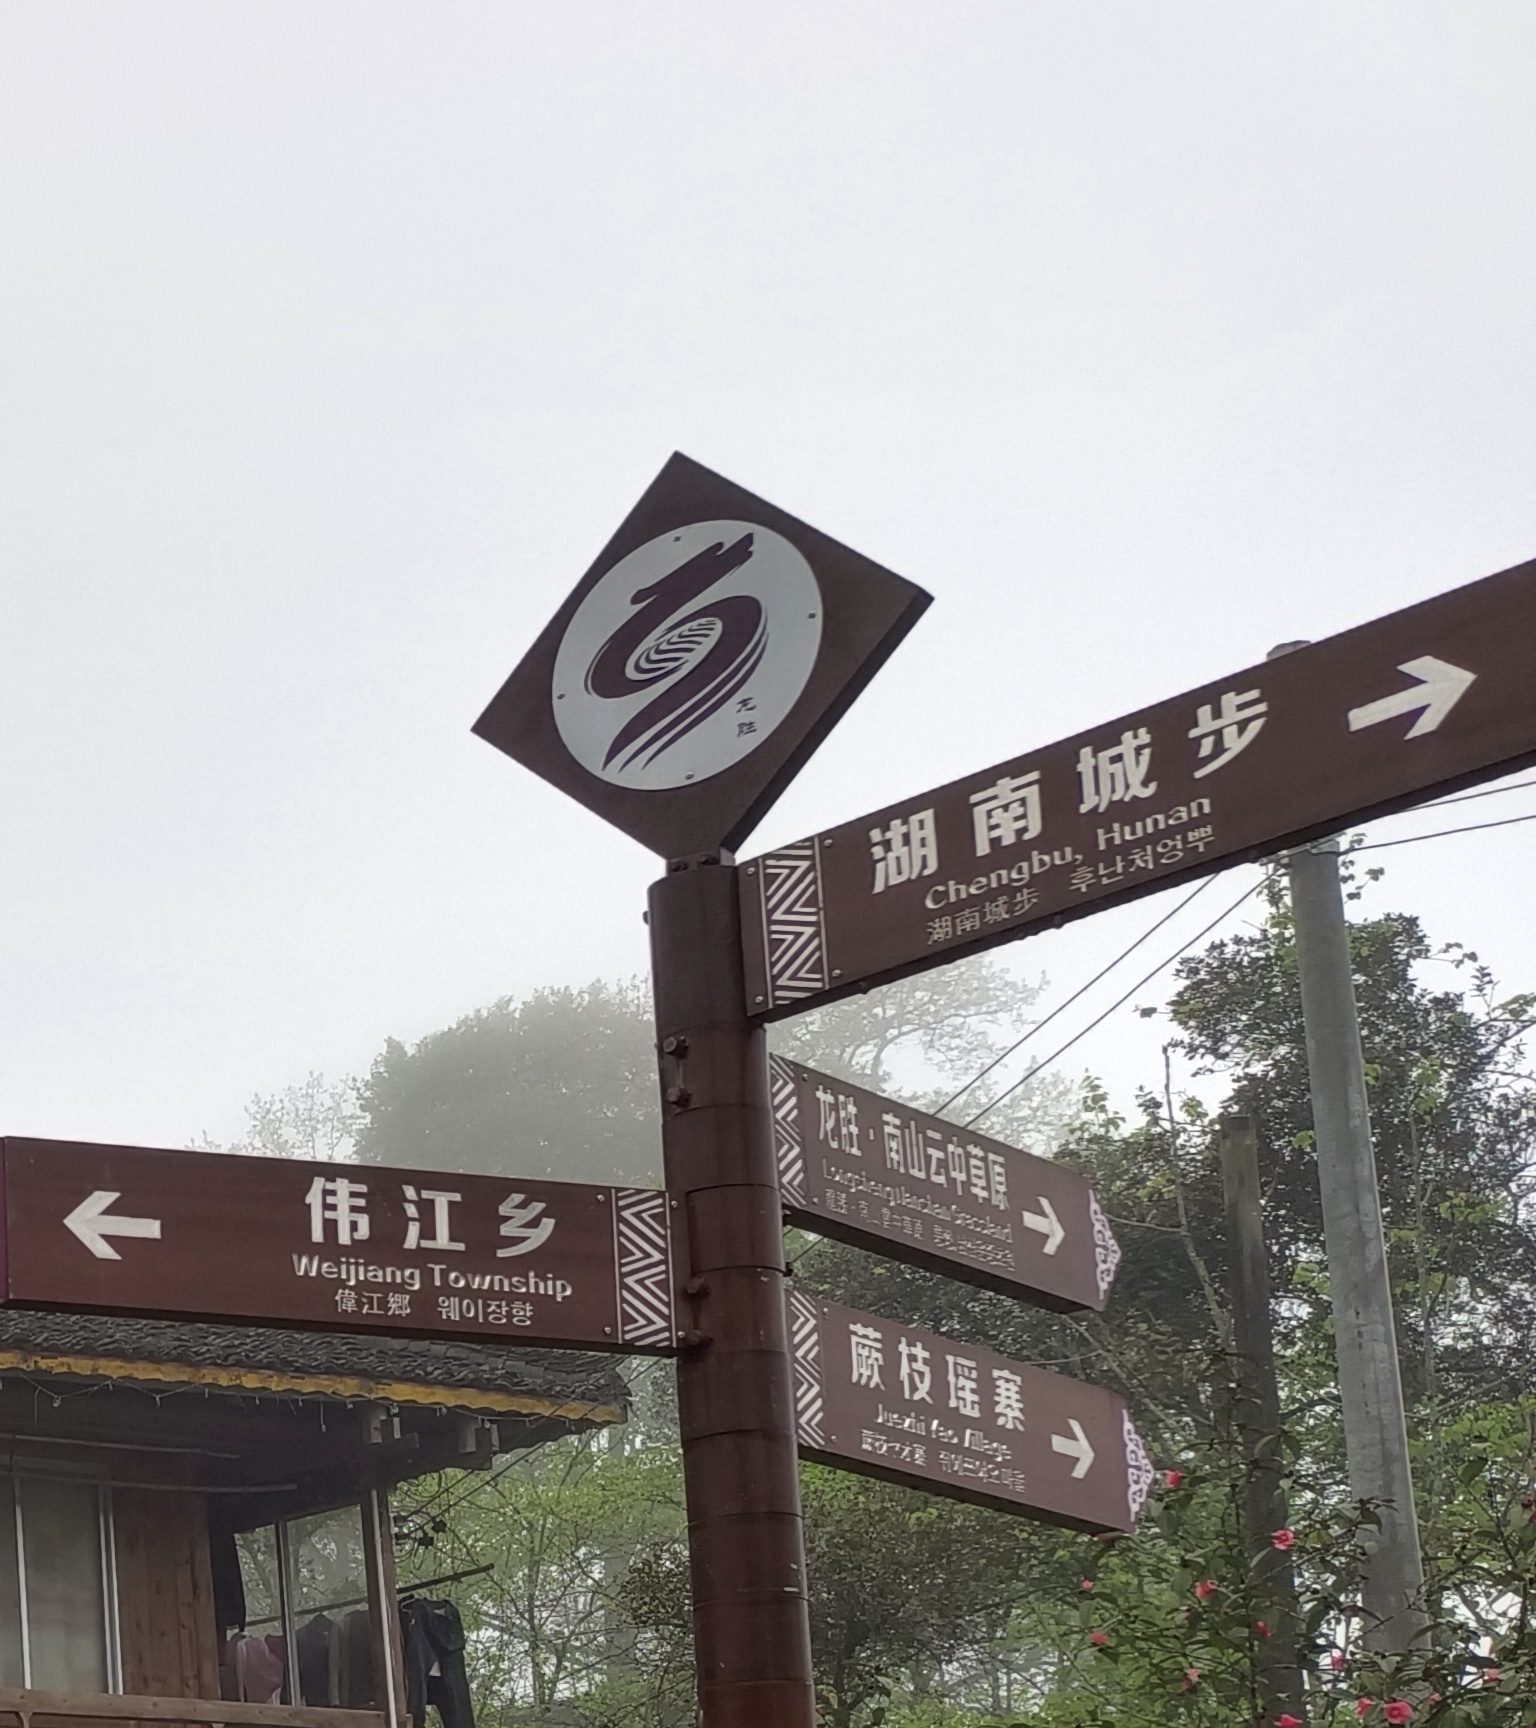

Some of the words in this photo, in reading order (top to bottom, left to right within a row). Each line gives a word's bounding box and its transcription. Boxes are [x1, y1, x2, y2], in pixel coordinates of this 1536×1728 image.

[868, 687, 1269, 895] 湖南城步
[925, 846, 1083, 909] Chengbu,
[1096, 798, 1212, 850] Hunan
[926, 887, 1040, 945] 湖南城步
[303, 1175, 557, 1259] 伟江乡
[291, 1252, 421, 1291] Weijiang
[426, 1263, 573, 1302] Township
[436, 1296, 534, 1326] 웨이장향
[848, 1322, 1026, 1432] 蕨枝瑶寨
